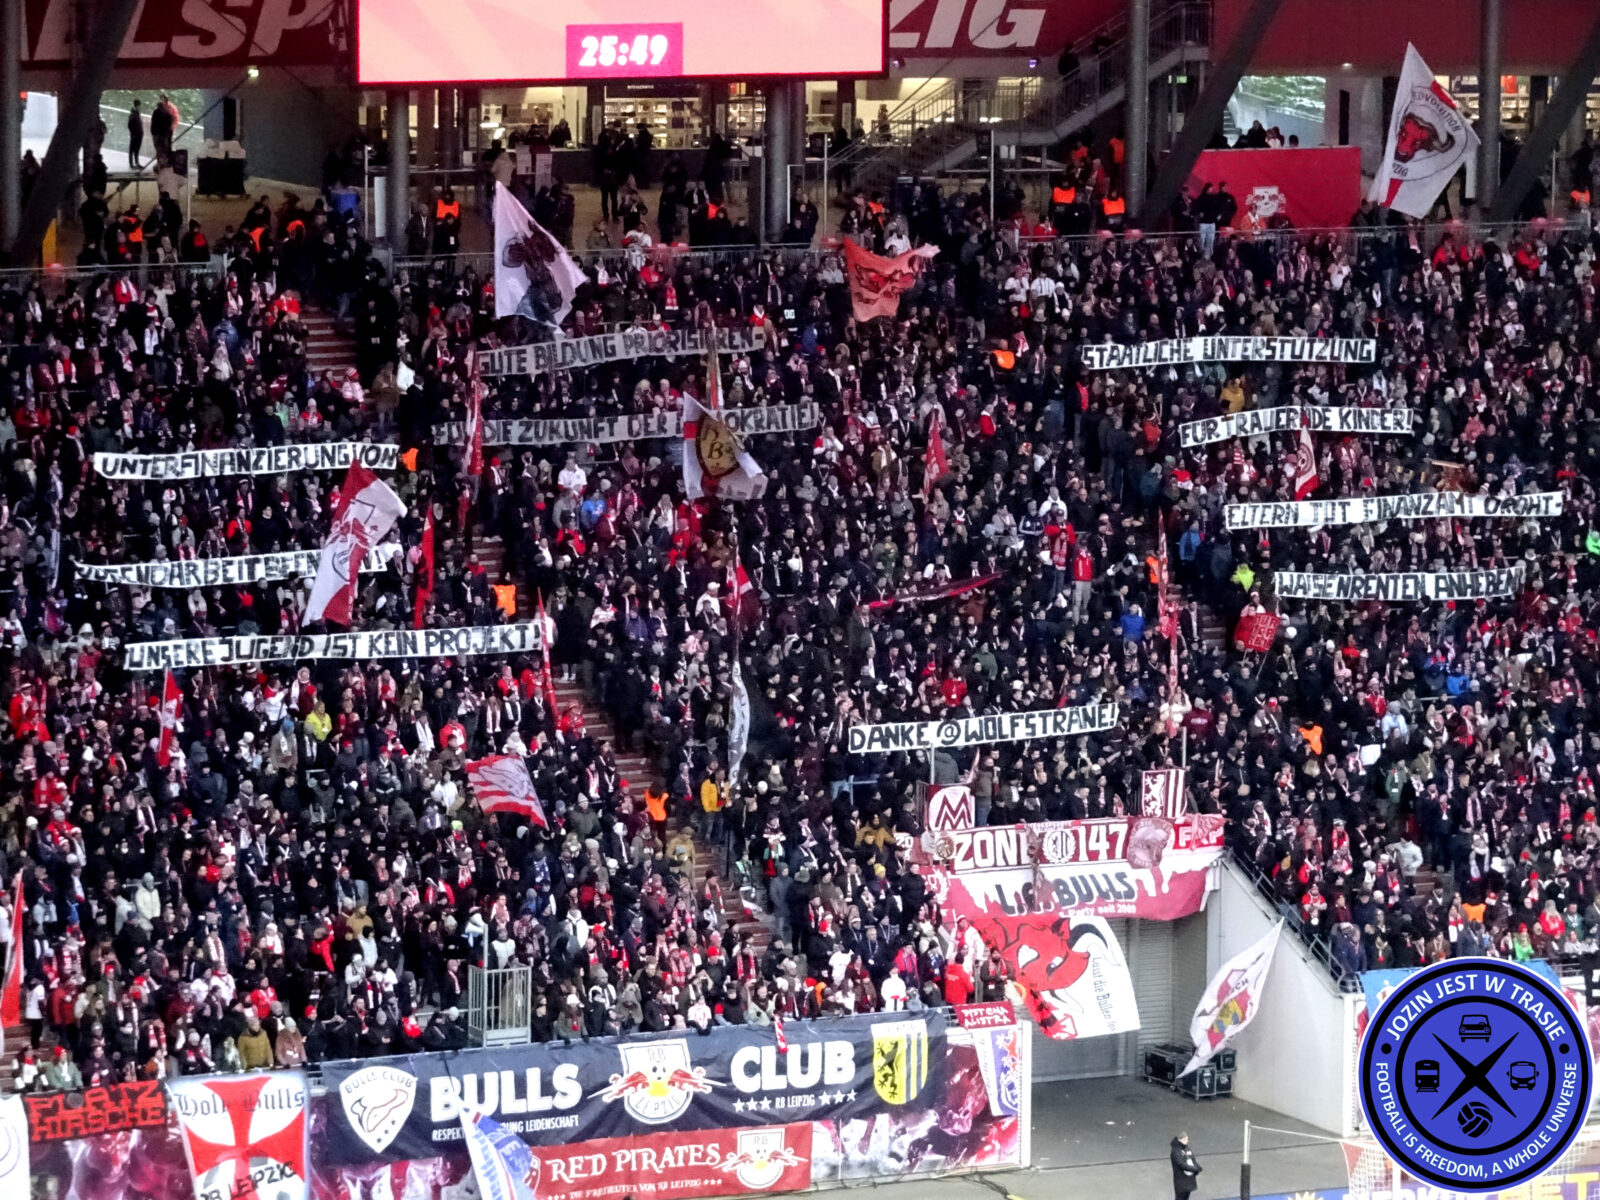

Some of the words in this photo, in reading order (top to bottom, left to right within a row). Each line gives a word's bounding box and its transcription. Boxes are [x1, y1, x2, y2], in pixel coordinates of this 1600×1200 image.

[578, 34, 668, 66] 25:49
[478, 348, 528, 374] GUTE
[534, 334, 617, 368] BILDUNG
[518, 416, 620, 443] ZUKUNFT
[1339, 407, 1413, 431] KINDER!
[101, 445, 349, 479] UNTERFINANZIERUNG
[1228, 503, 1299, 527] ELTERN
[1278, 572, 1425, 599] WAISENRENTEN
[127, 640, 215, 669] UNSERE
[220, 634, 314, 662] JUGEND
[322, 634, 361, 658] IST
[367, 631, 418, 657] KEIN
[425, 624, 540, 655] PROJEKT!
[851, 723, 931, 751] DANKE
[1054, 872, 1136, 909] BULLS
[1098, 904, 1115, 913] seit
[1117, 904, 1136, 914] 2009
[383, 1070, 413, 1088] CLUB
[431, 1064, 583, 1122] BULLS
[730, 1040, 855, 1093] CLUB
[775, 1098, 787, 1109] RB
[788, 1095, 815, 1108] LEIPZIG
[526, 1115, 579, 1132] LEIDENSCHAFT
[545, 1153, 607, 1184] RED
[612, 1142, 720, 1175] PIRATES
